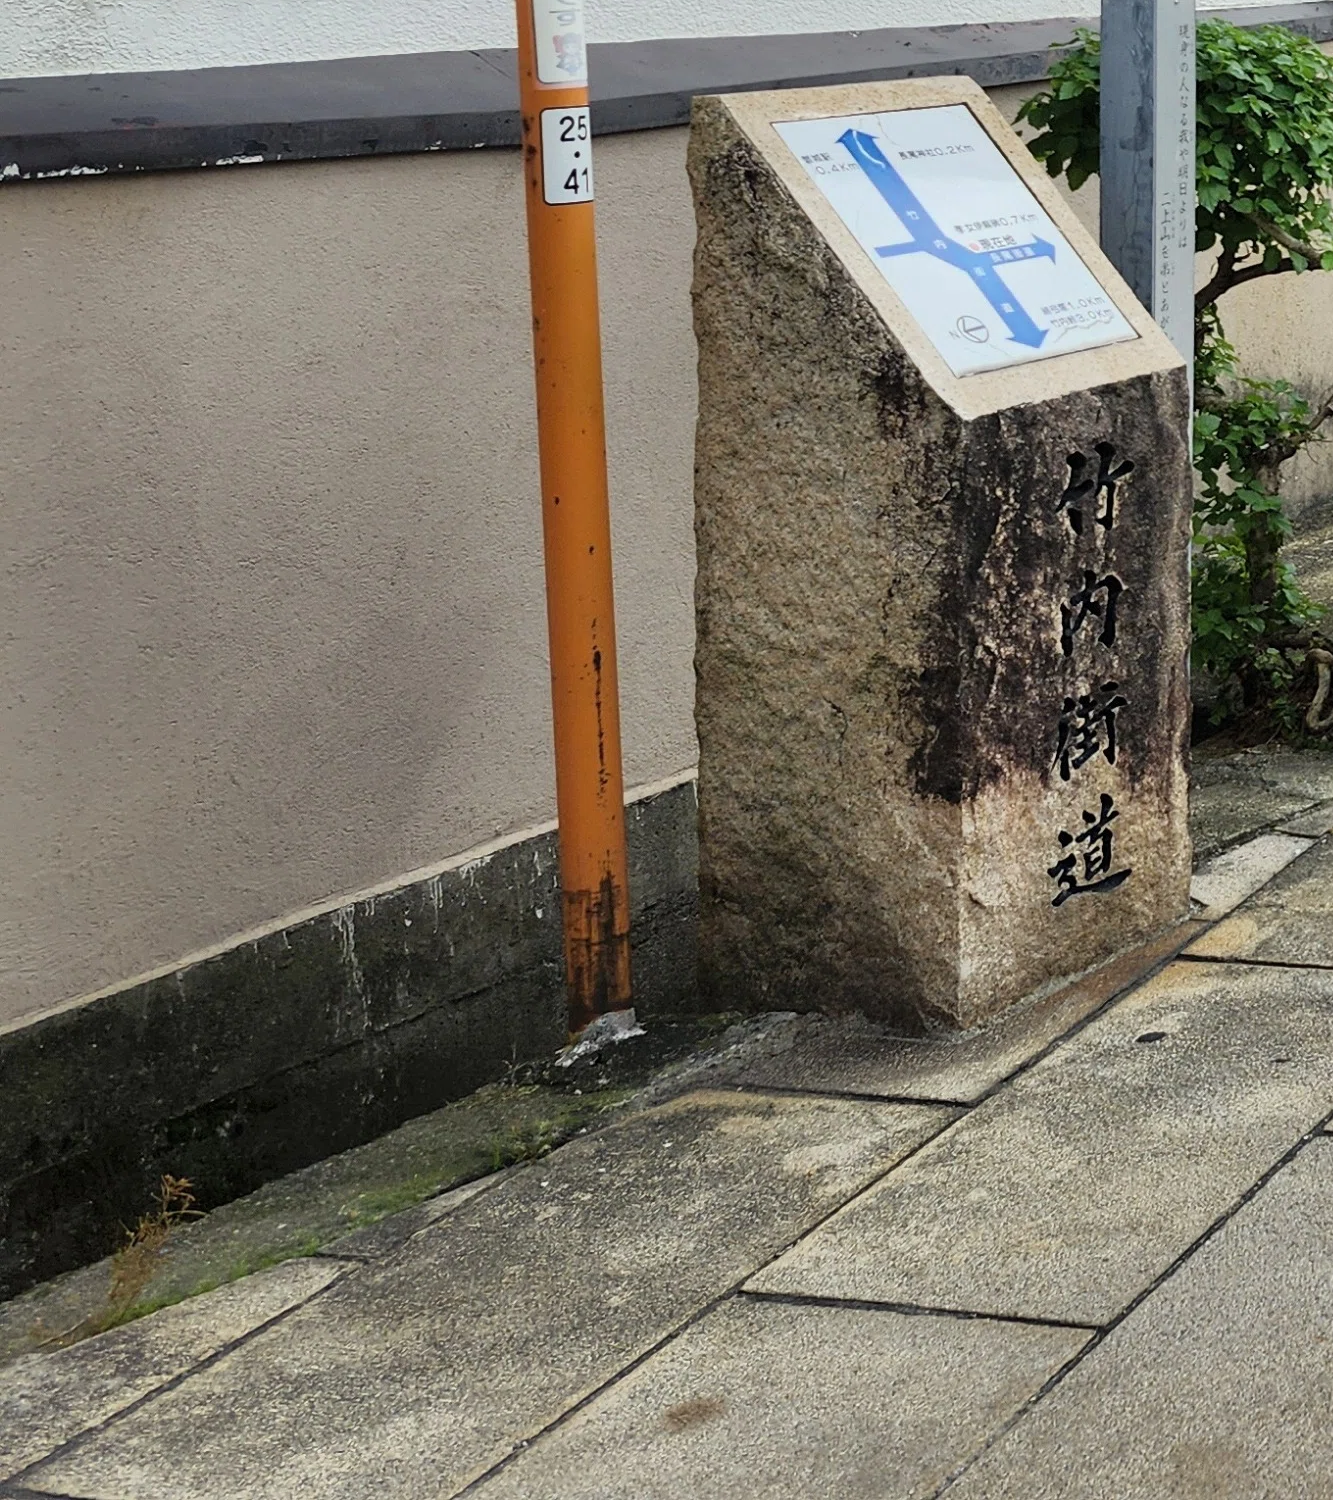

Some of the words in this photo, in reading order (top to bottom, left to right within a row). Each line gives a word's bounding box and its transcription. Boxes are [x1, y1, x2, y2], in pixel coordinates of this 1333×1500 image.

[559, 115, 588, 142] 25
[564, 167, 589, 194] 41
[949, 331, 961, 340] N
[1049, 440, 1137, 908] 竹内街道
